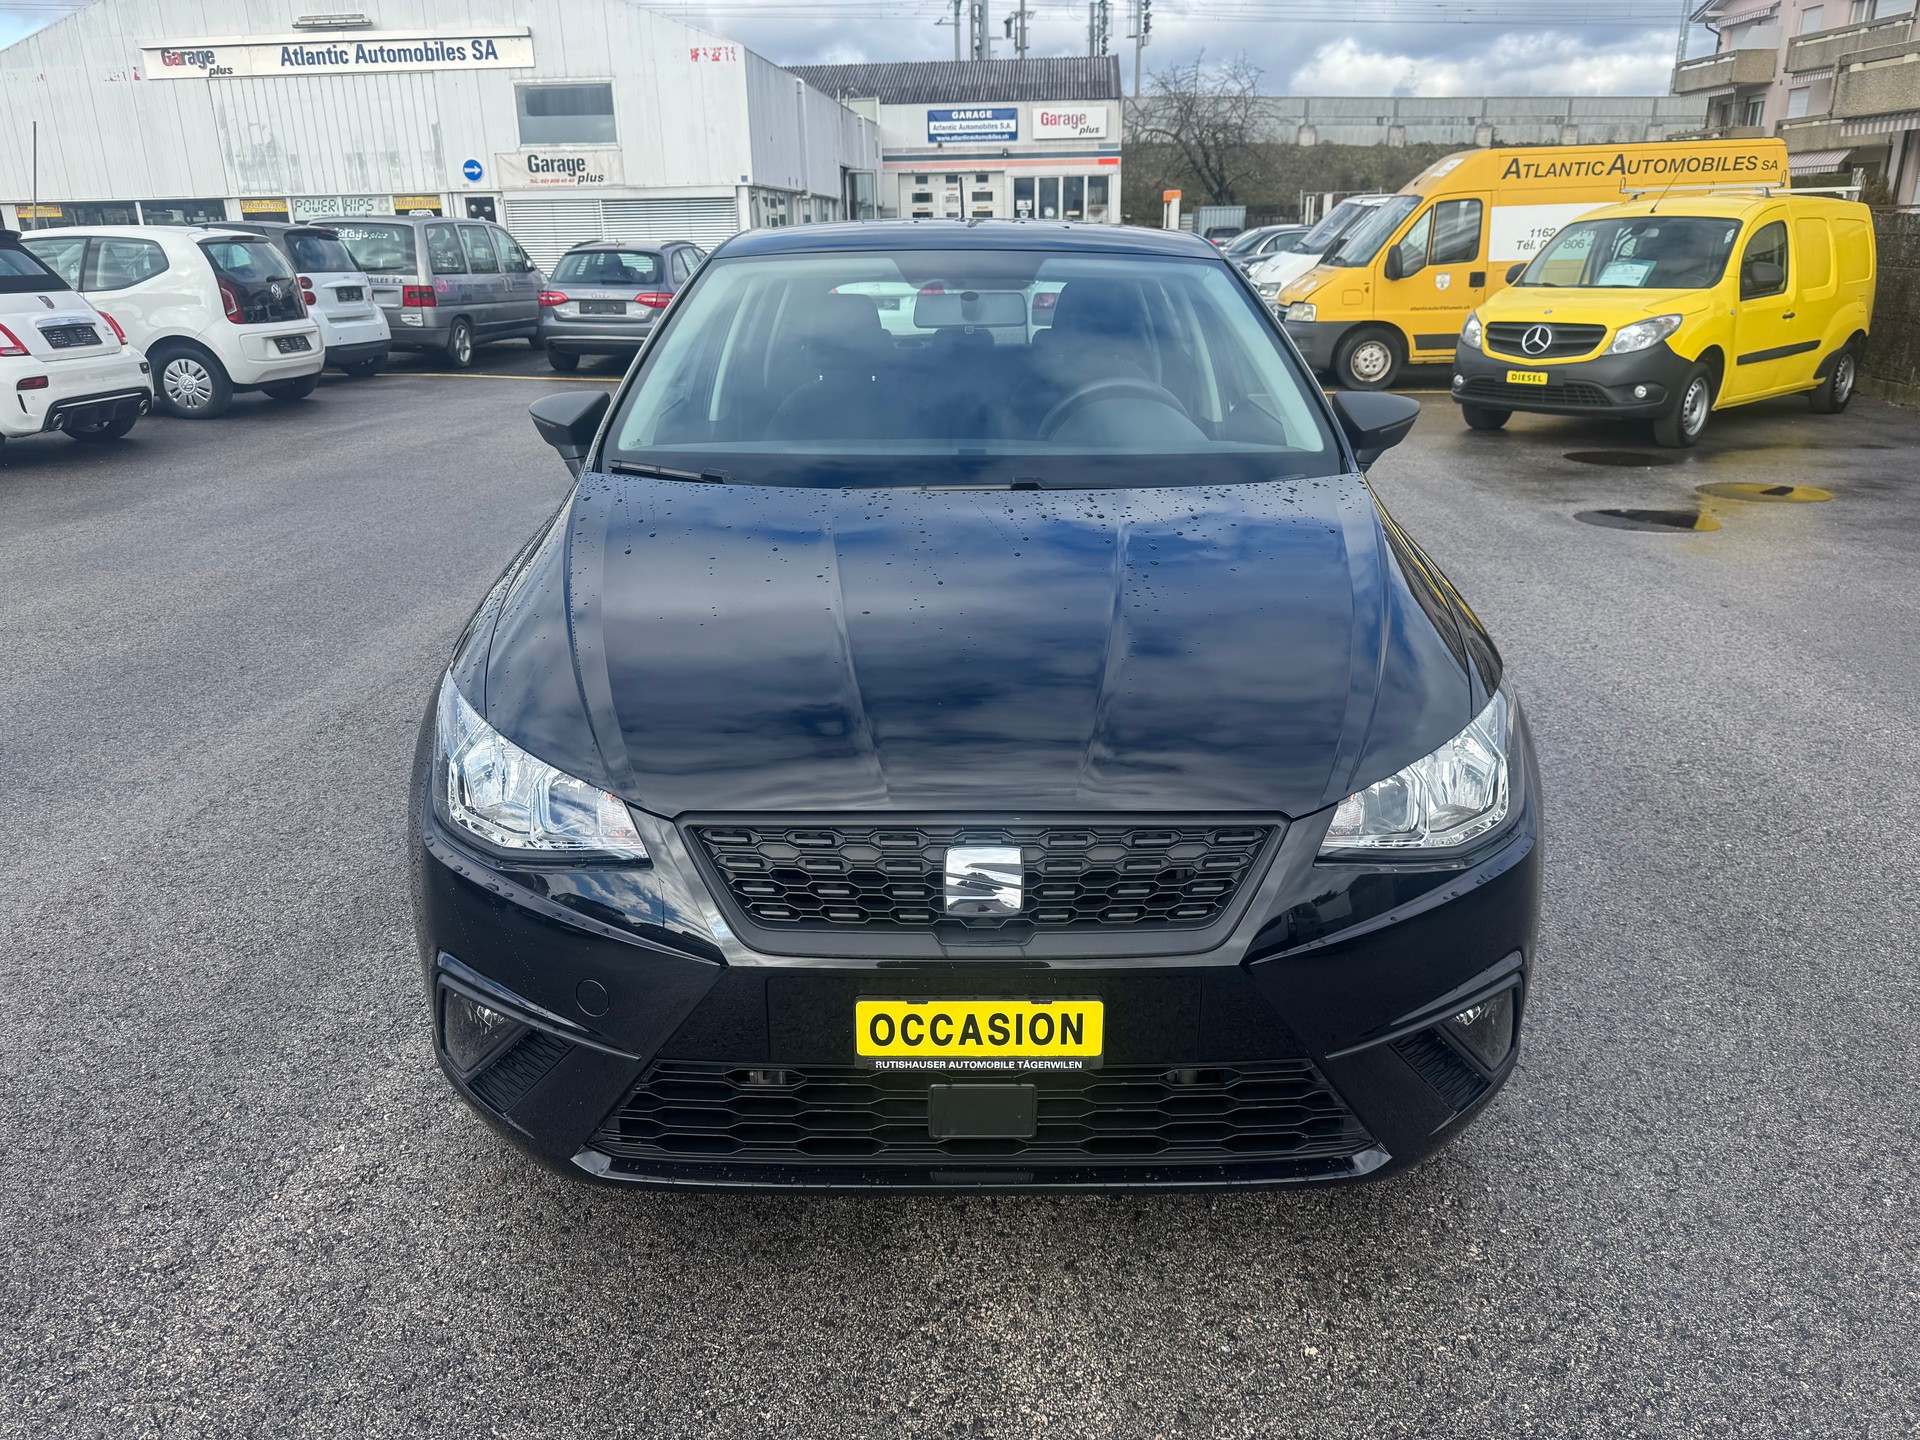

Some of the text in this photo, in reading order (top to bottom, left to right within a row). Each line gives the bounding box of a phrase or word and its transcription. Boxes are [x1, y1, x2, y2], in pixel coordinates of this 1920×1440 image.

[281, 39, 498, 66] Atlantic Automobiles SA
[161, 49, 215, 69] Garage
[208, 64, 234, 77] plus
[951, 110, 993, 120] GARAGE
[1041, 112, 1086, 129] Garage
[1079, 125, 1100, 136] plus
[527, 154, 585, 176] Garage
[1761, 160, 1778, 171] SA
[578, 172, 604, 184] plus
[1517, 240, 1536, 250] Tél.
[1511, 373, 1543, 382] DIESEL
[869, 1012, 1084, 1047] OCCASION
[875, 1059, 1083, 1069] RUTISHAUSER AUTOMOBILE TÄGERWILEN
